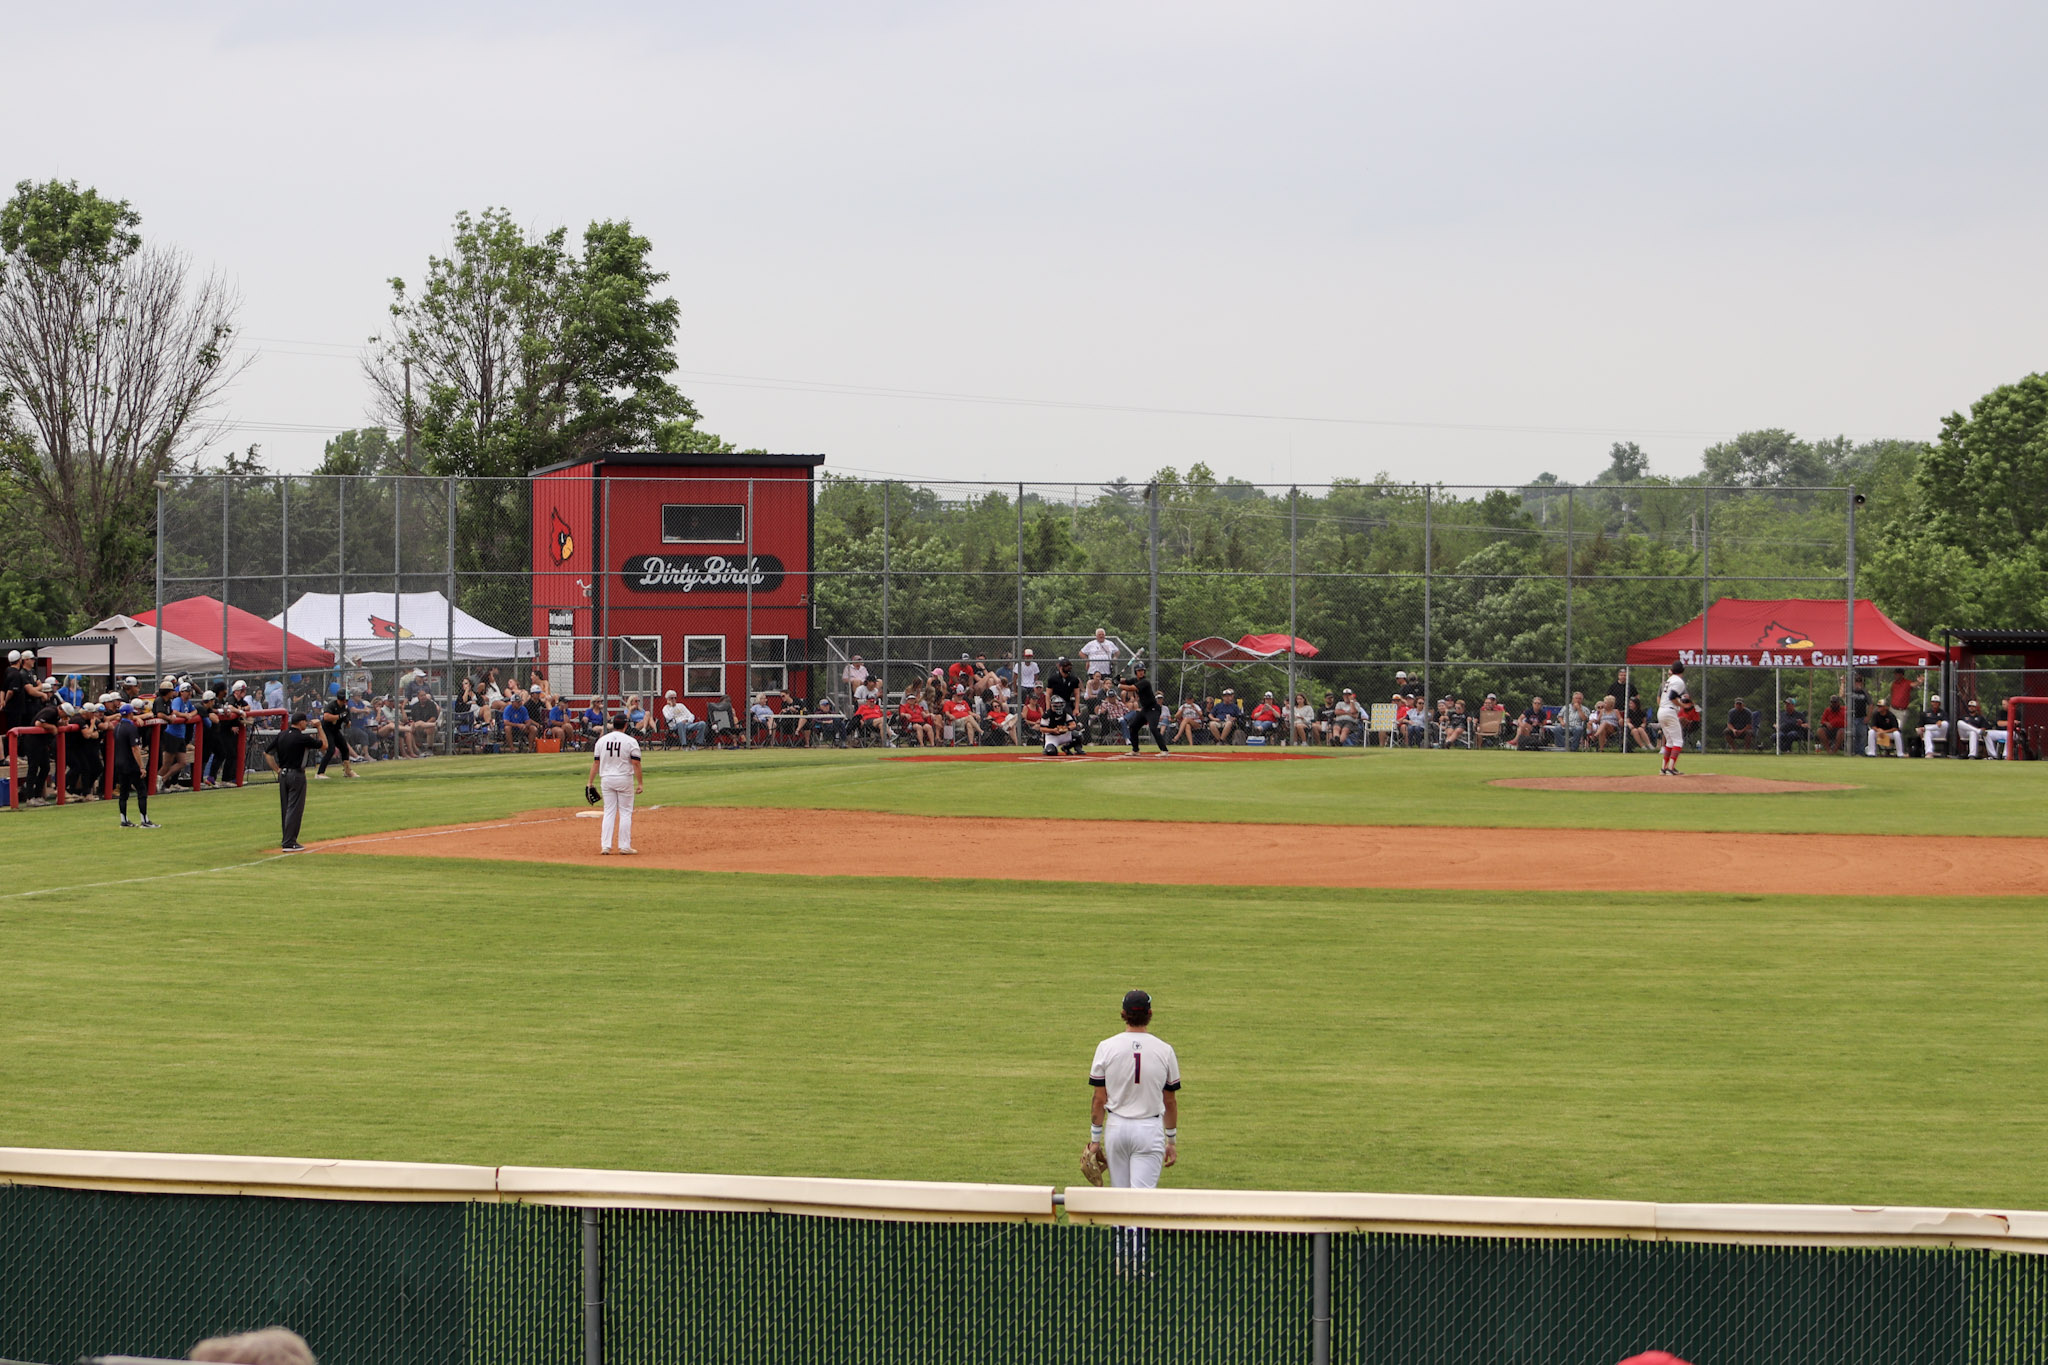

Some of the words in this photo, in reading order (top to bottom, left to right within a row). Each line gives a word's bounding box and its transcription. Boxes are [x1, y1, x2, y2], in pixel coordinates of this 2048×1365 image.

[640, 557, 701, 593] Dirty
[700, 556, 764, 585] Birds
[1678, 650, 1752, 666] MINERAL
[1759, 650, 1804, 666] AREA
[1811, 650, 1879, 666] COLLEGE
[606, 741, 622, 758] 44
[1133, 1052, 1142, 1085] 1
